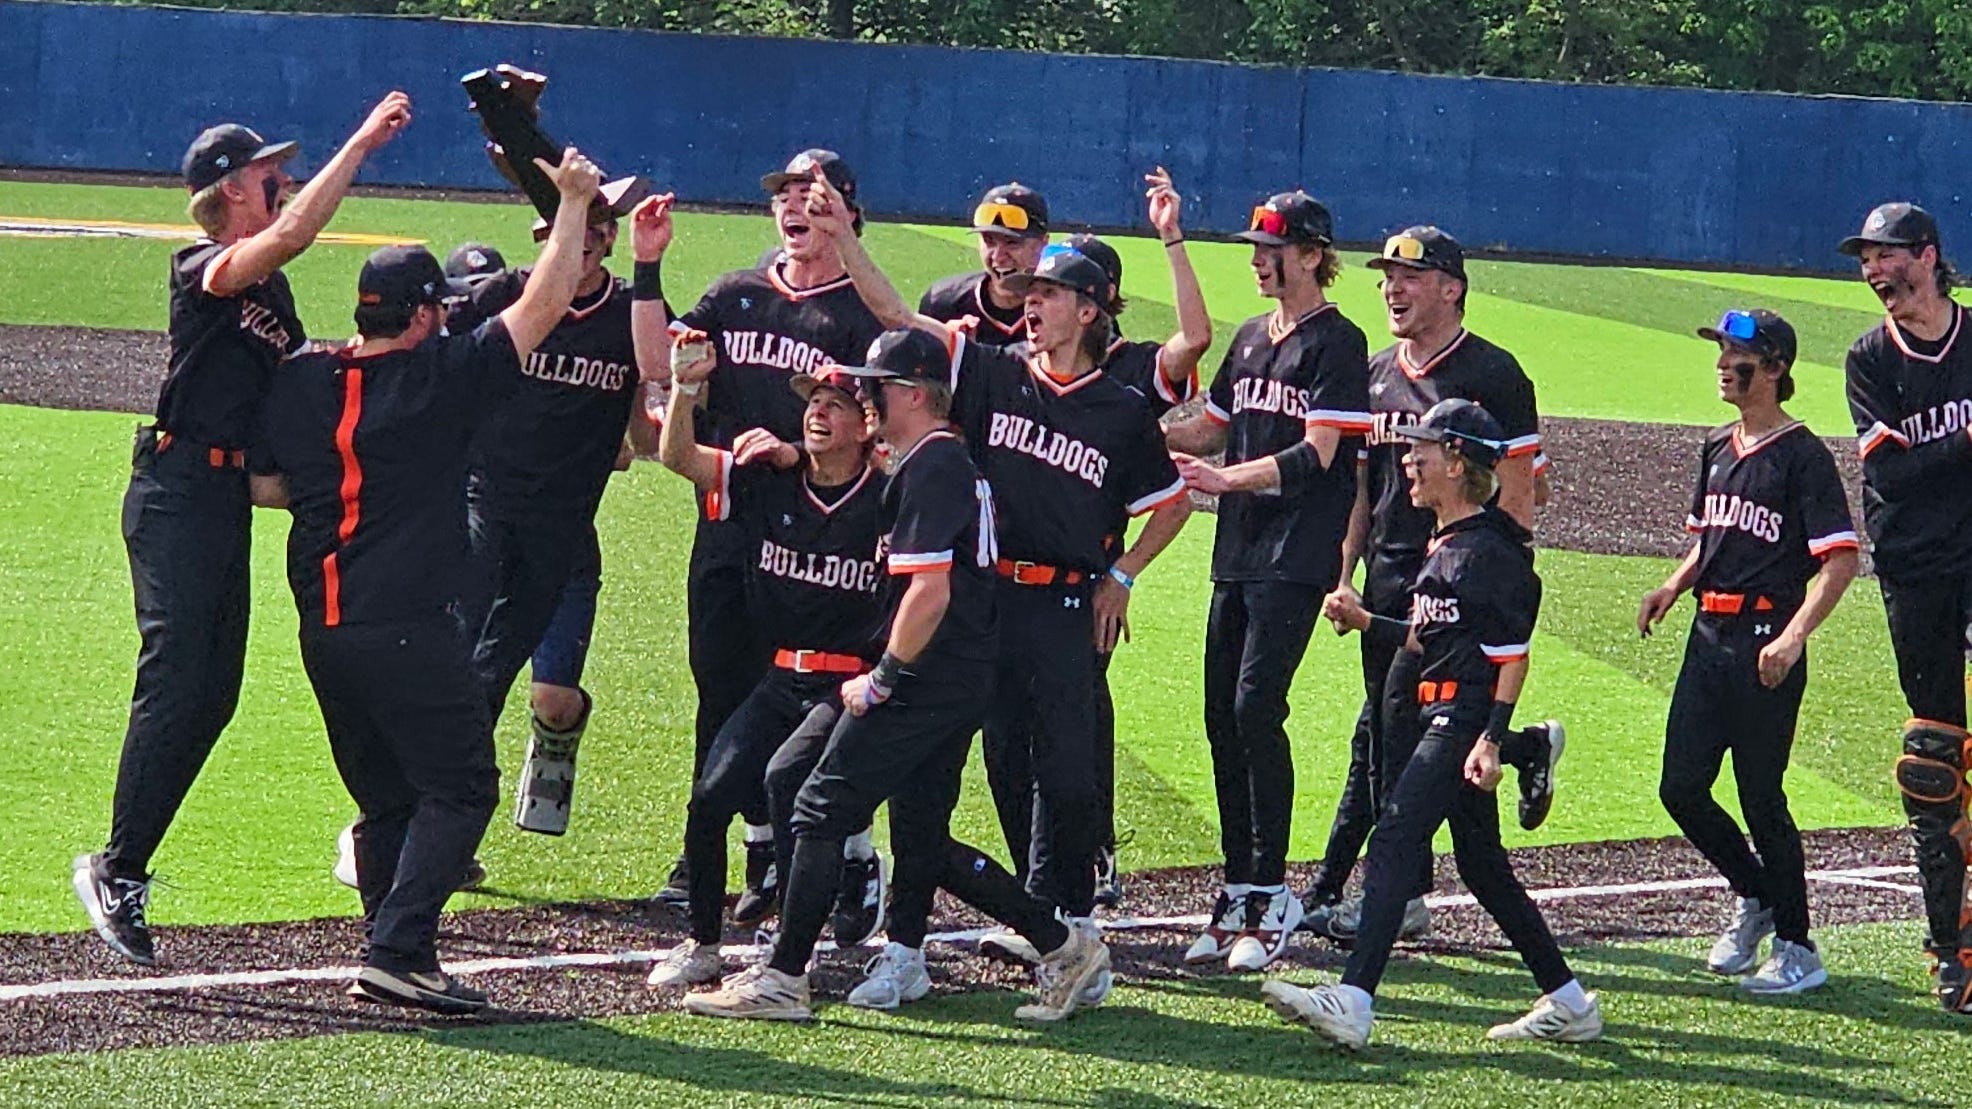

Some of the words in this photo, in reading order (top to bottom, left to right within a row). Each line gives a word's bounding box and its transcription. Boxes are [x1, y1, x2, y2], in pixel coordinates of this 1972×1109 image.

[521, 352, 629, 391] ULLDOGS
[723, 330, 836, 377] ULLDOG
[988, 412, 1109, 488] BULLDOGS
[1702, 493, 1783, 543] ULLDOGS
[759, 540, 877, 593] BULLDOG
